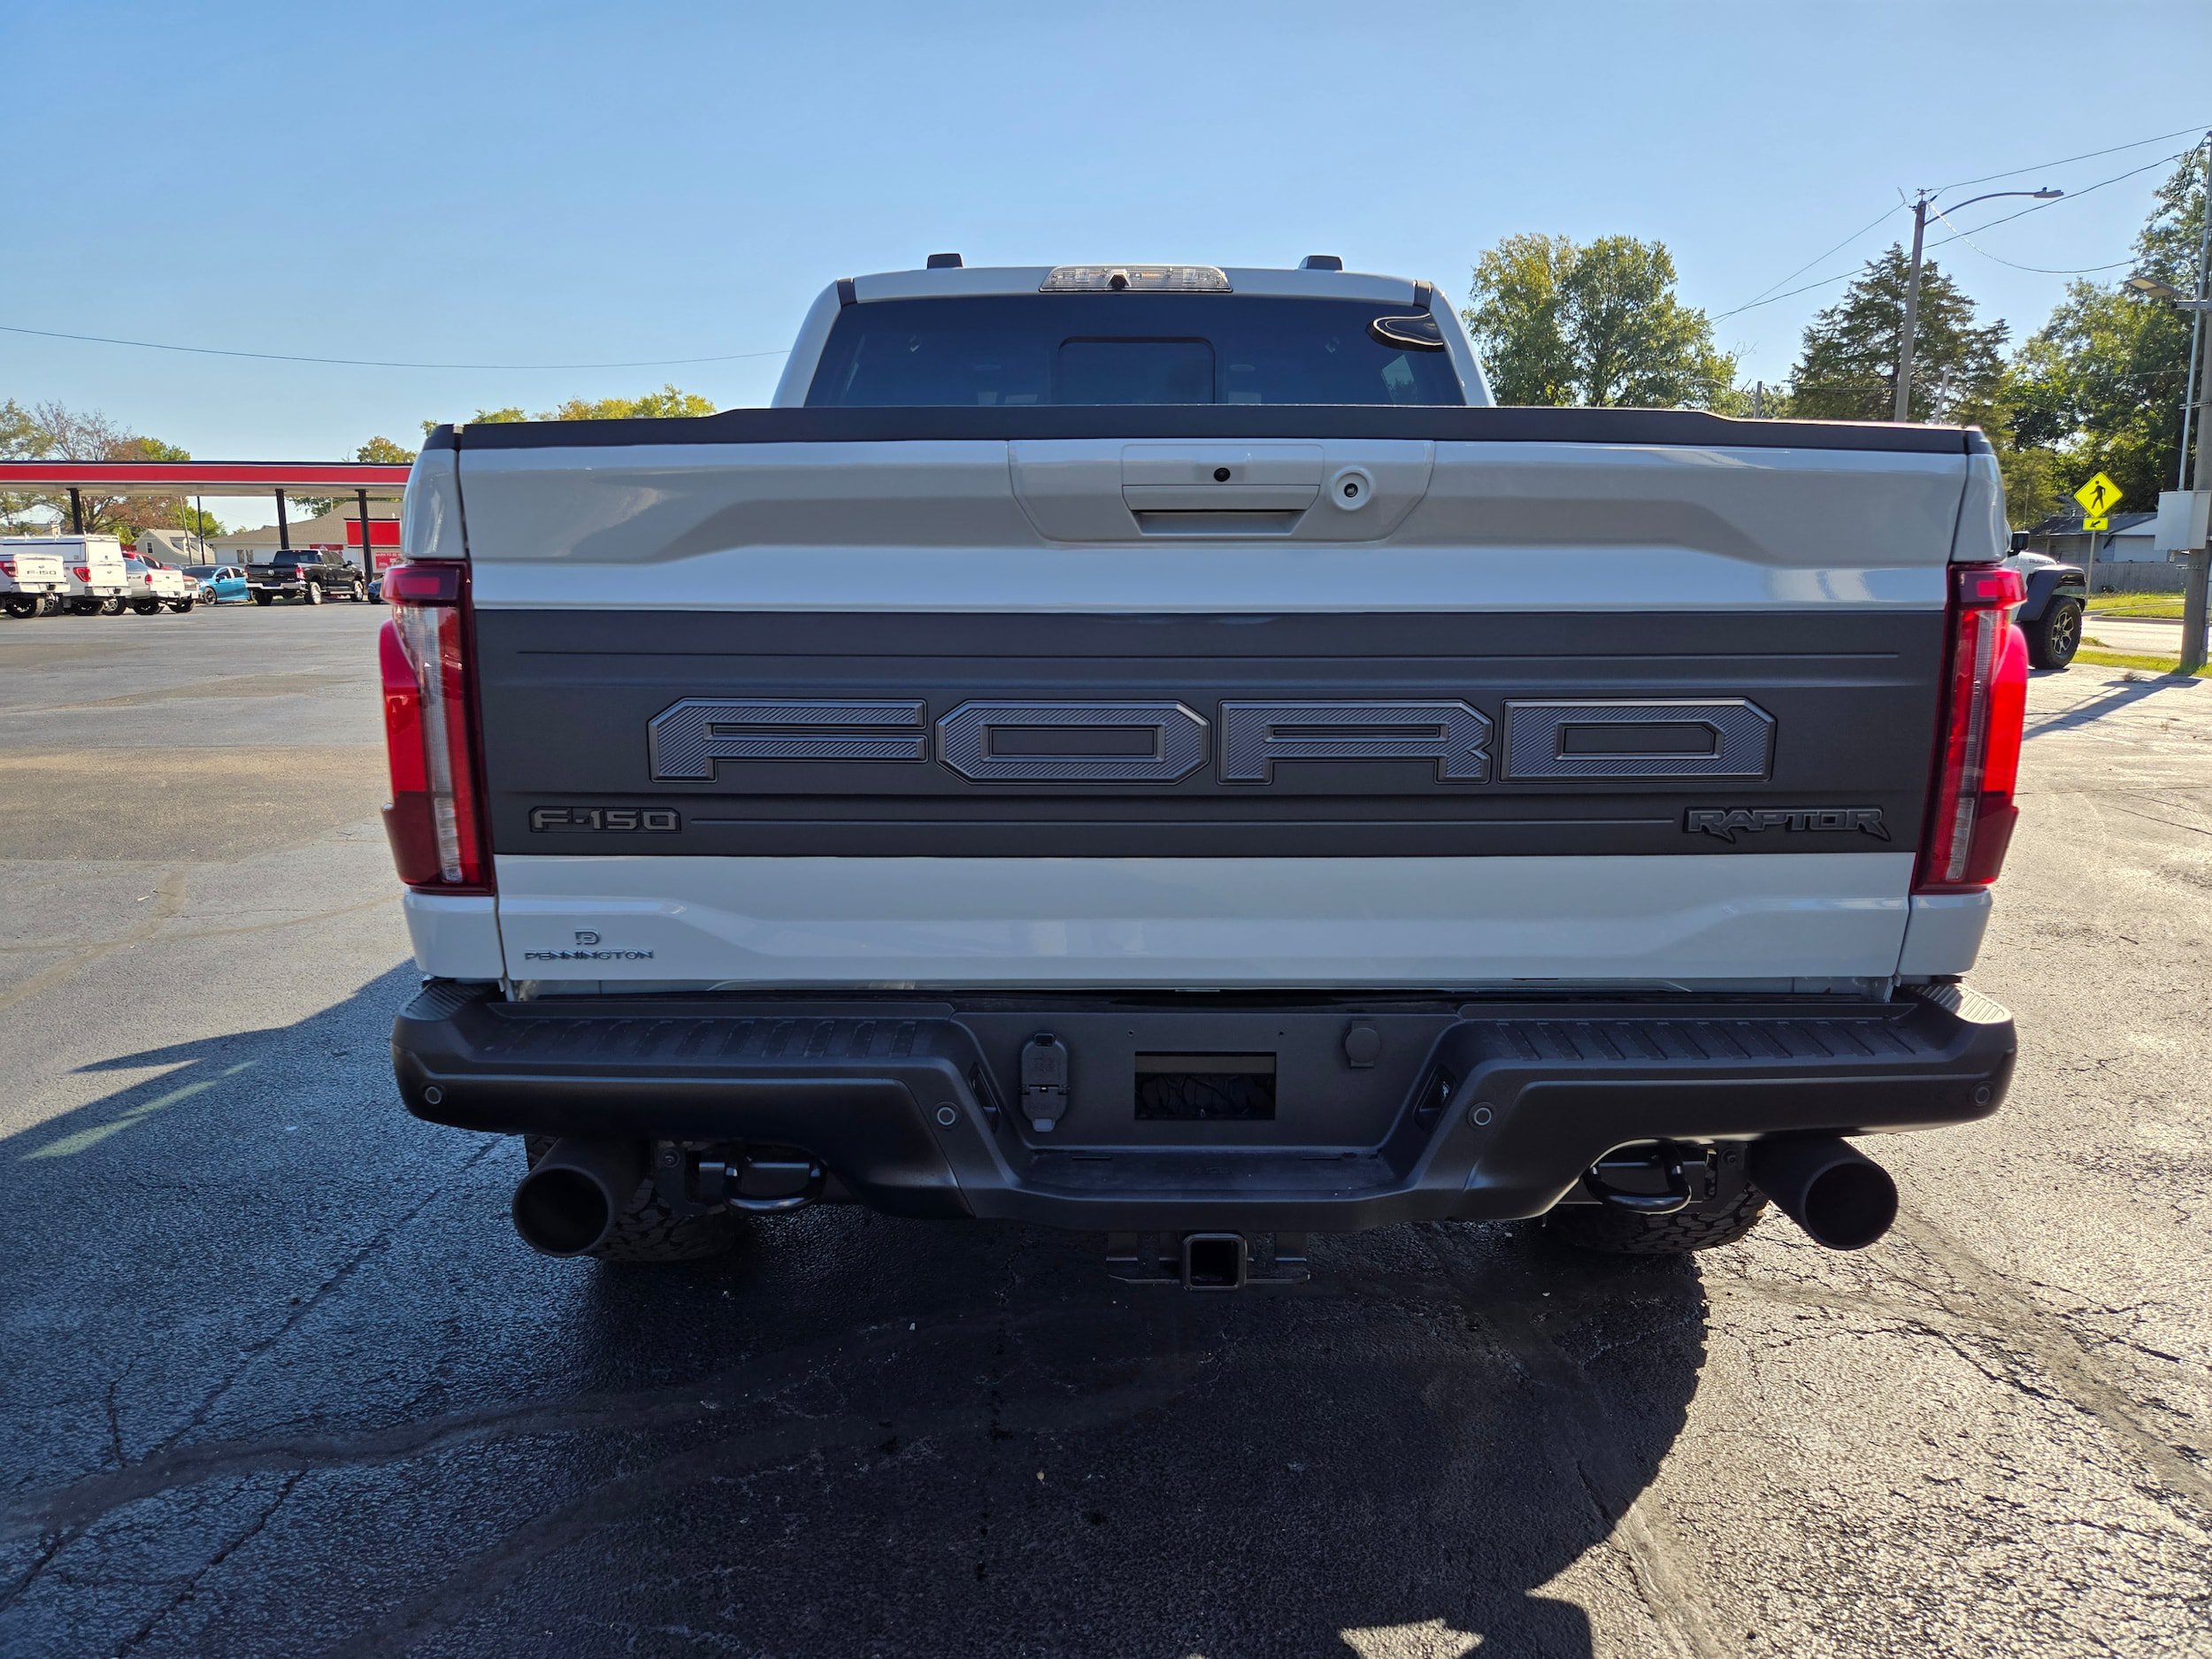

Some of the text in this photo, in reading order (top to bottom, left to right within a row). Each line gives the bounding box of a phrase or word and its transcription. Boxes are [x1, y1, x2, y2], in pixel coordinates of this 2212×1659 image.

[648, 696, 1778, 784] FORD
[533, 808, 678, 832] F-150
[1686, 809, 1891, 842] RAPTOR
[524, 949, 655, 961] PENNINGTON
